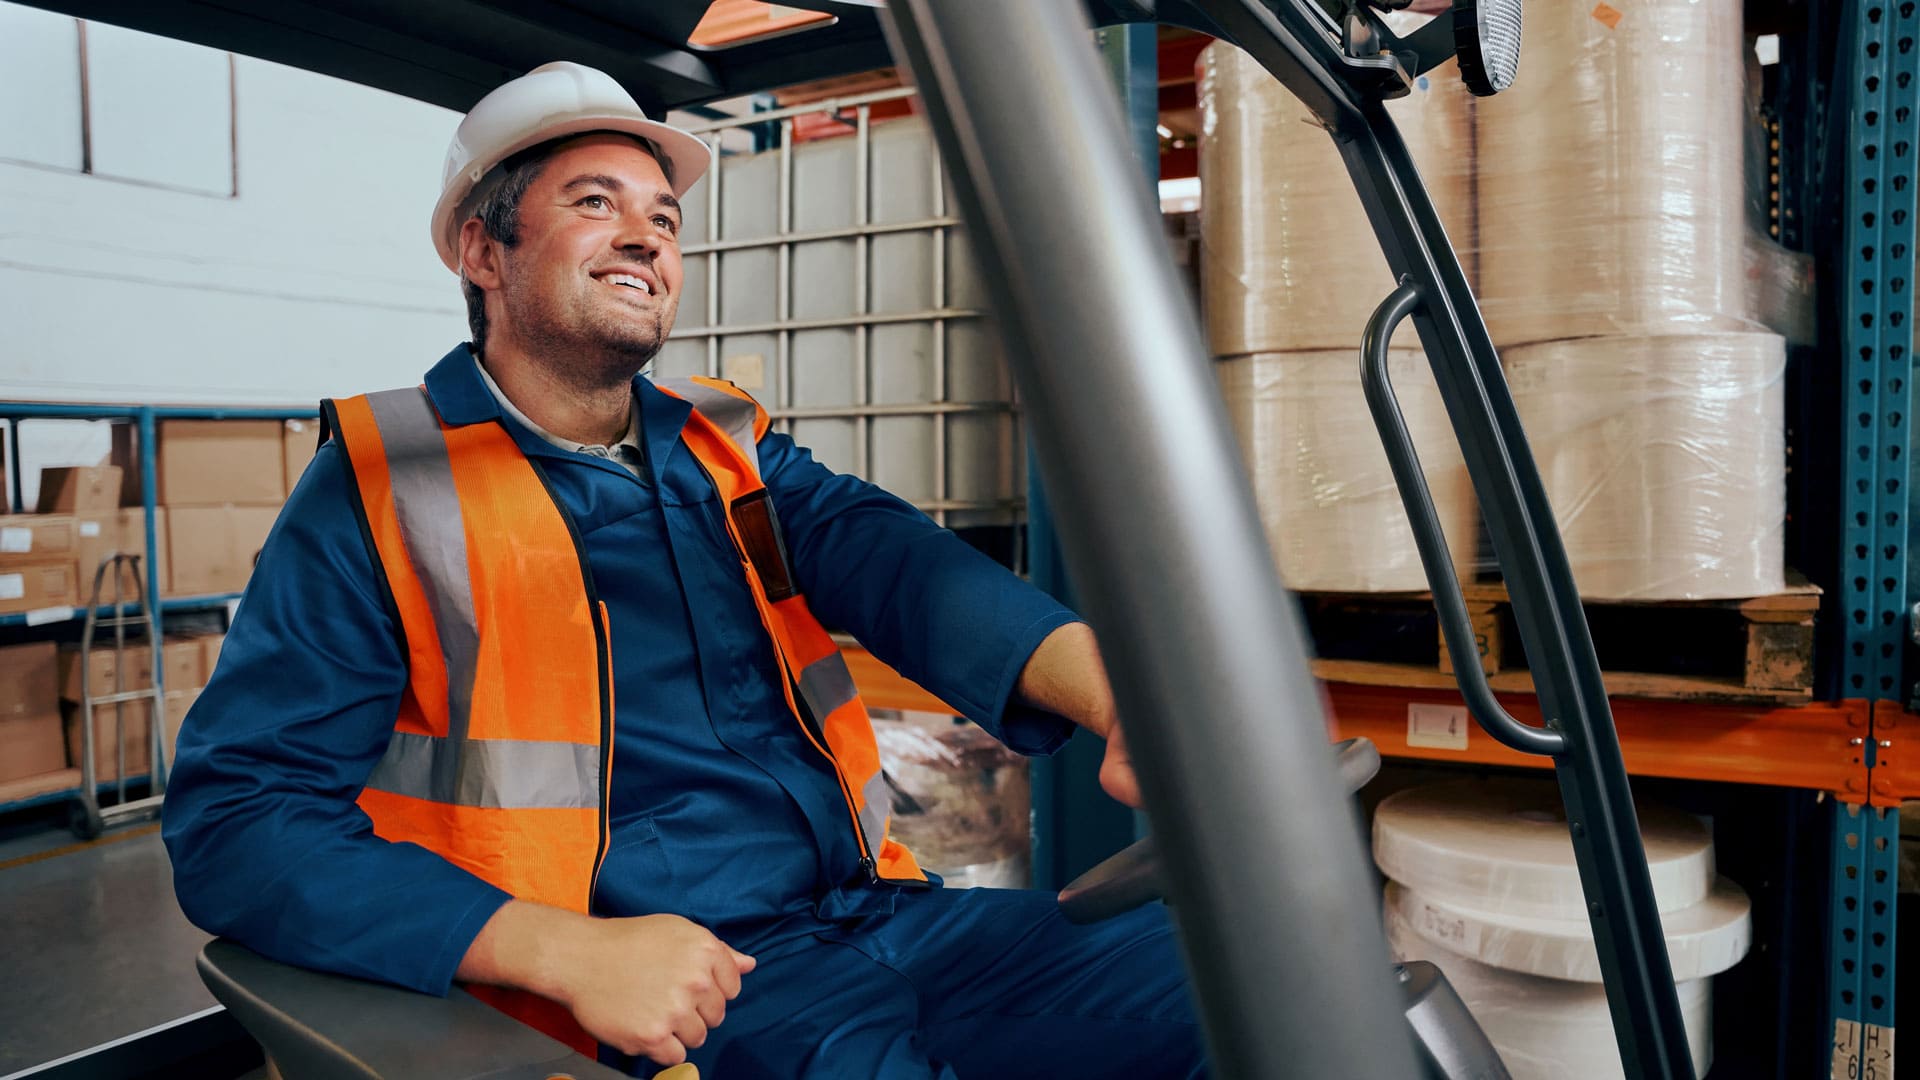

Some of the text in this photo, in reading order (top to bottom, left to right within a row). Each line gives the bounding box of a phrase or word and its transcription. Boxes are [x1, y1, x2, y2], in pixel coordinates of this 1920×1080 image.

[1447, 713, 1457, 737] 4
[1866, 1025, 1879, 1051] H
[1848, 1054, 1857, 1080] 6
[1866, 1057, 1876, 1080] 5
